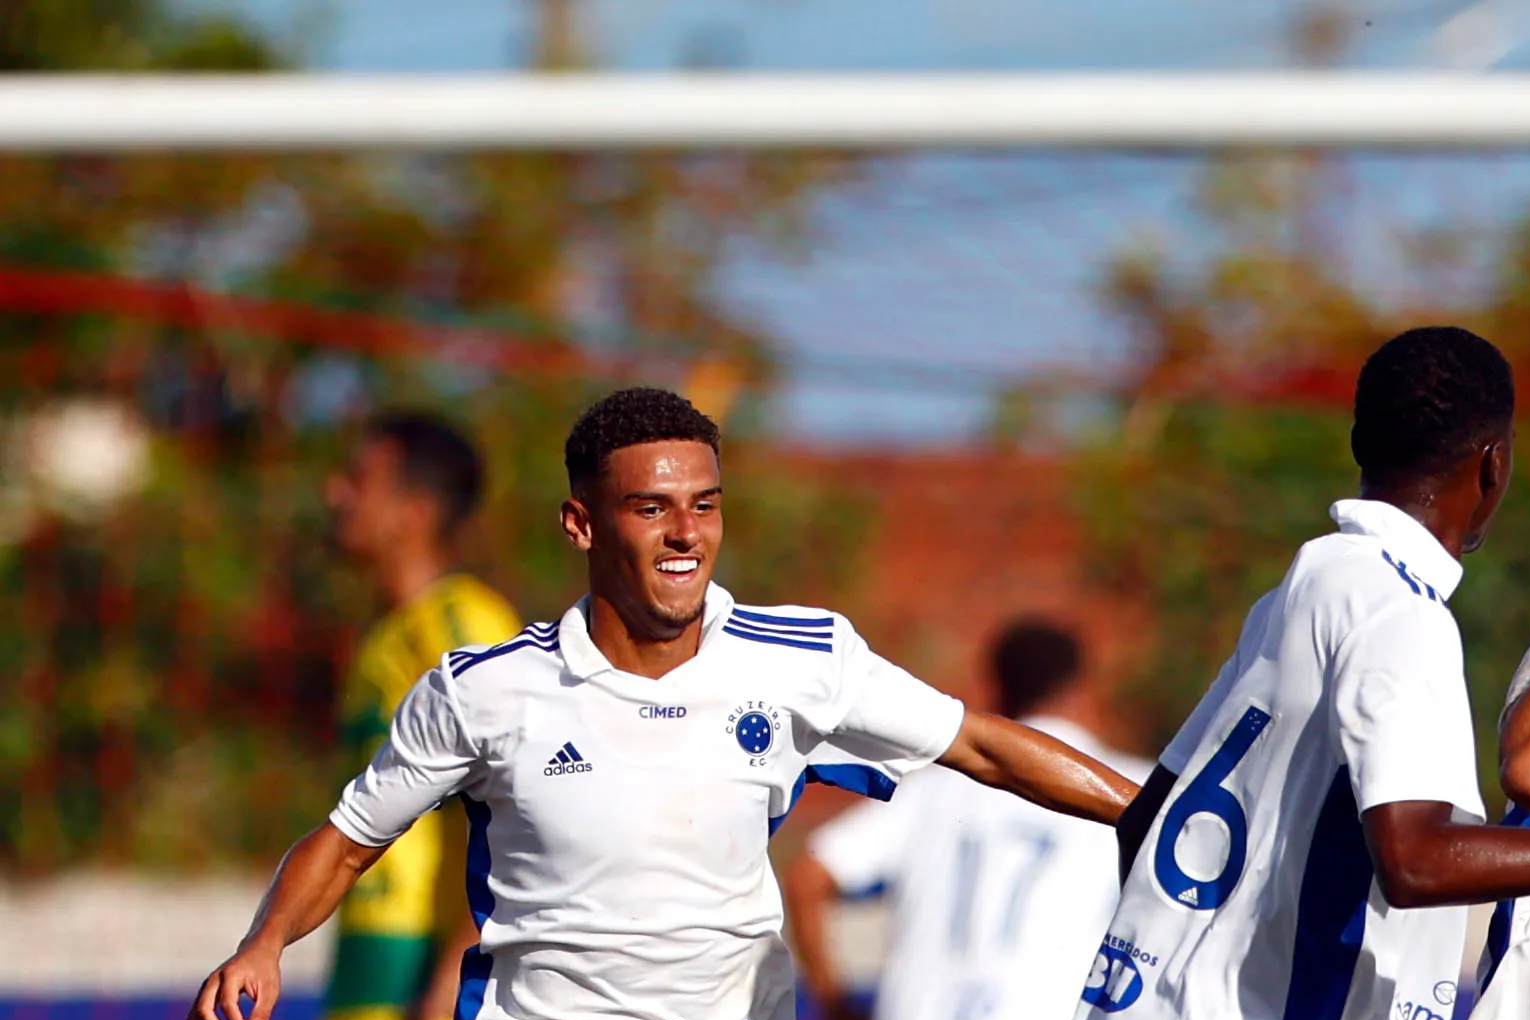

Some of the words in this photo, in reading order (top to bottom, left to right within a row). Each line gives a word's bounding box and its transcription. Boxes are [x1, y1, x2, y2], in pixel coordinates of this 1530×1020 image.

[638, 706, 687, 719] CIMED
[725, 700, 781, 734] CRUZEIRO
[543, 760, 593, 777] adidas
[1154, 705, 1272, 910] 6
[948, 815, 1058, 955] 17
